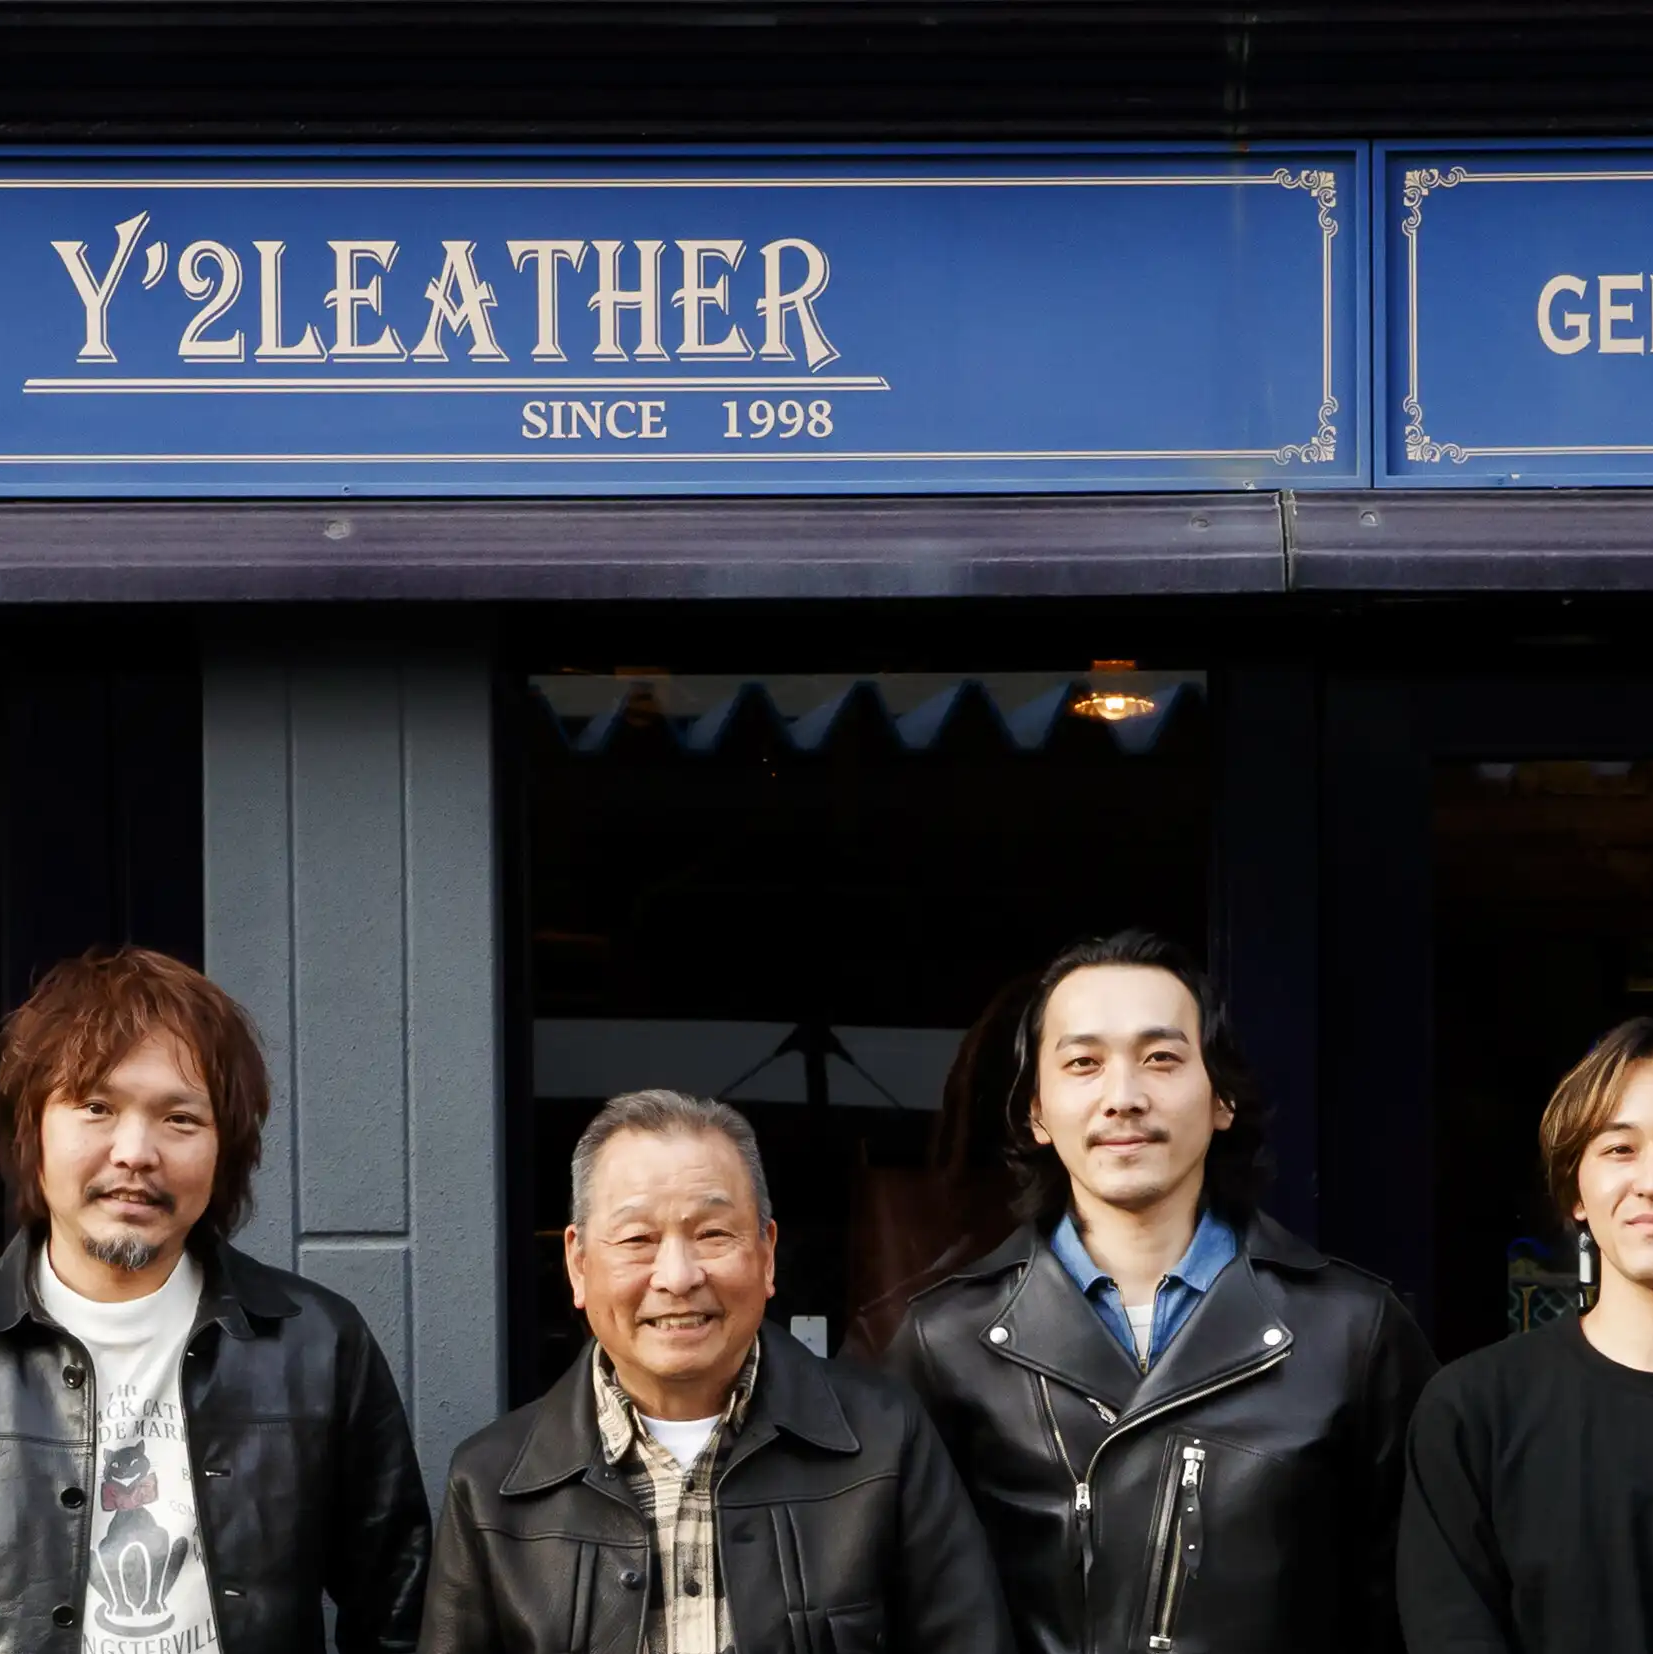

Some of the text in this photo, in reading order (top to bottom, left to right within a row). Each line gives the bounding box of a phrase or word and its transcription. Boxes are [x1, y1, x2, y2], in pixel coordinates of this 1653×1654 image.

[50, 210, 841, 373] Y'2LEATHER
[521, 400, 834, 439] SINCE 1998
[143, 1399, 178, 1420] CAT
